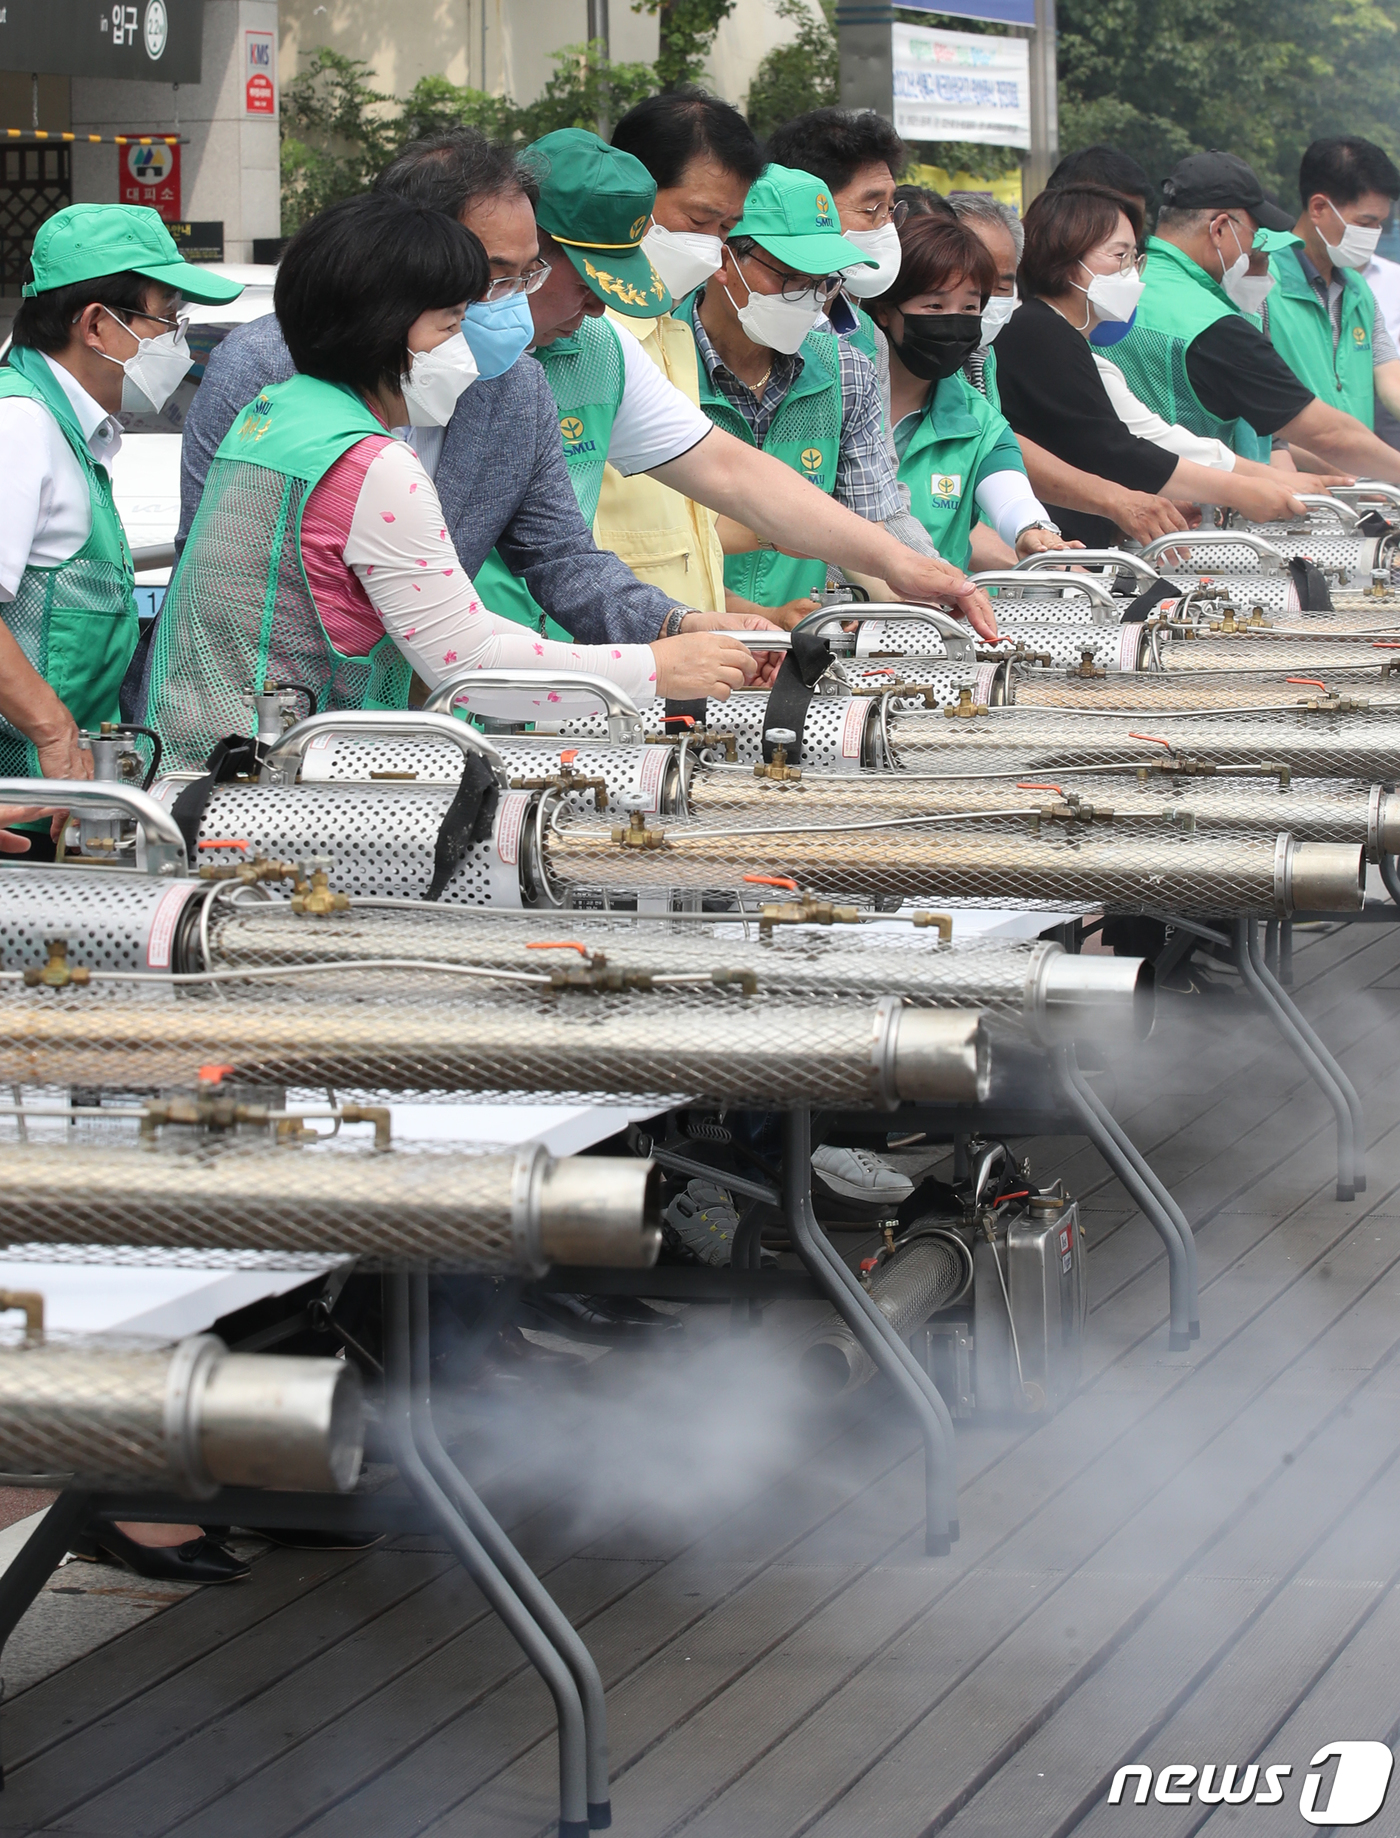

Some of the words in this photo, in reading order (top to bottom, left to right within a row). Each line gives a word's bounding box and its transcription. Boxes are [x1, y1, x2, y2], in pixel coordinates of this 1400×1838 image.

[100, 14, 109, 32] in
[112, 4, 138, 46] 입구
[250, 43, 269, 65] KMS
[126, 187, 174, 201] 대피소
[816, 217, 834, 228] SMU
[253, 399, 274, 415] SMU
[562, 440, 596, 458] SMU
[807, 474, 825, 485] MU
[931, 497, 960, 510] SMU
